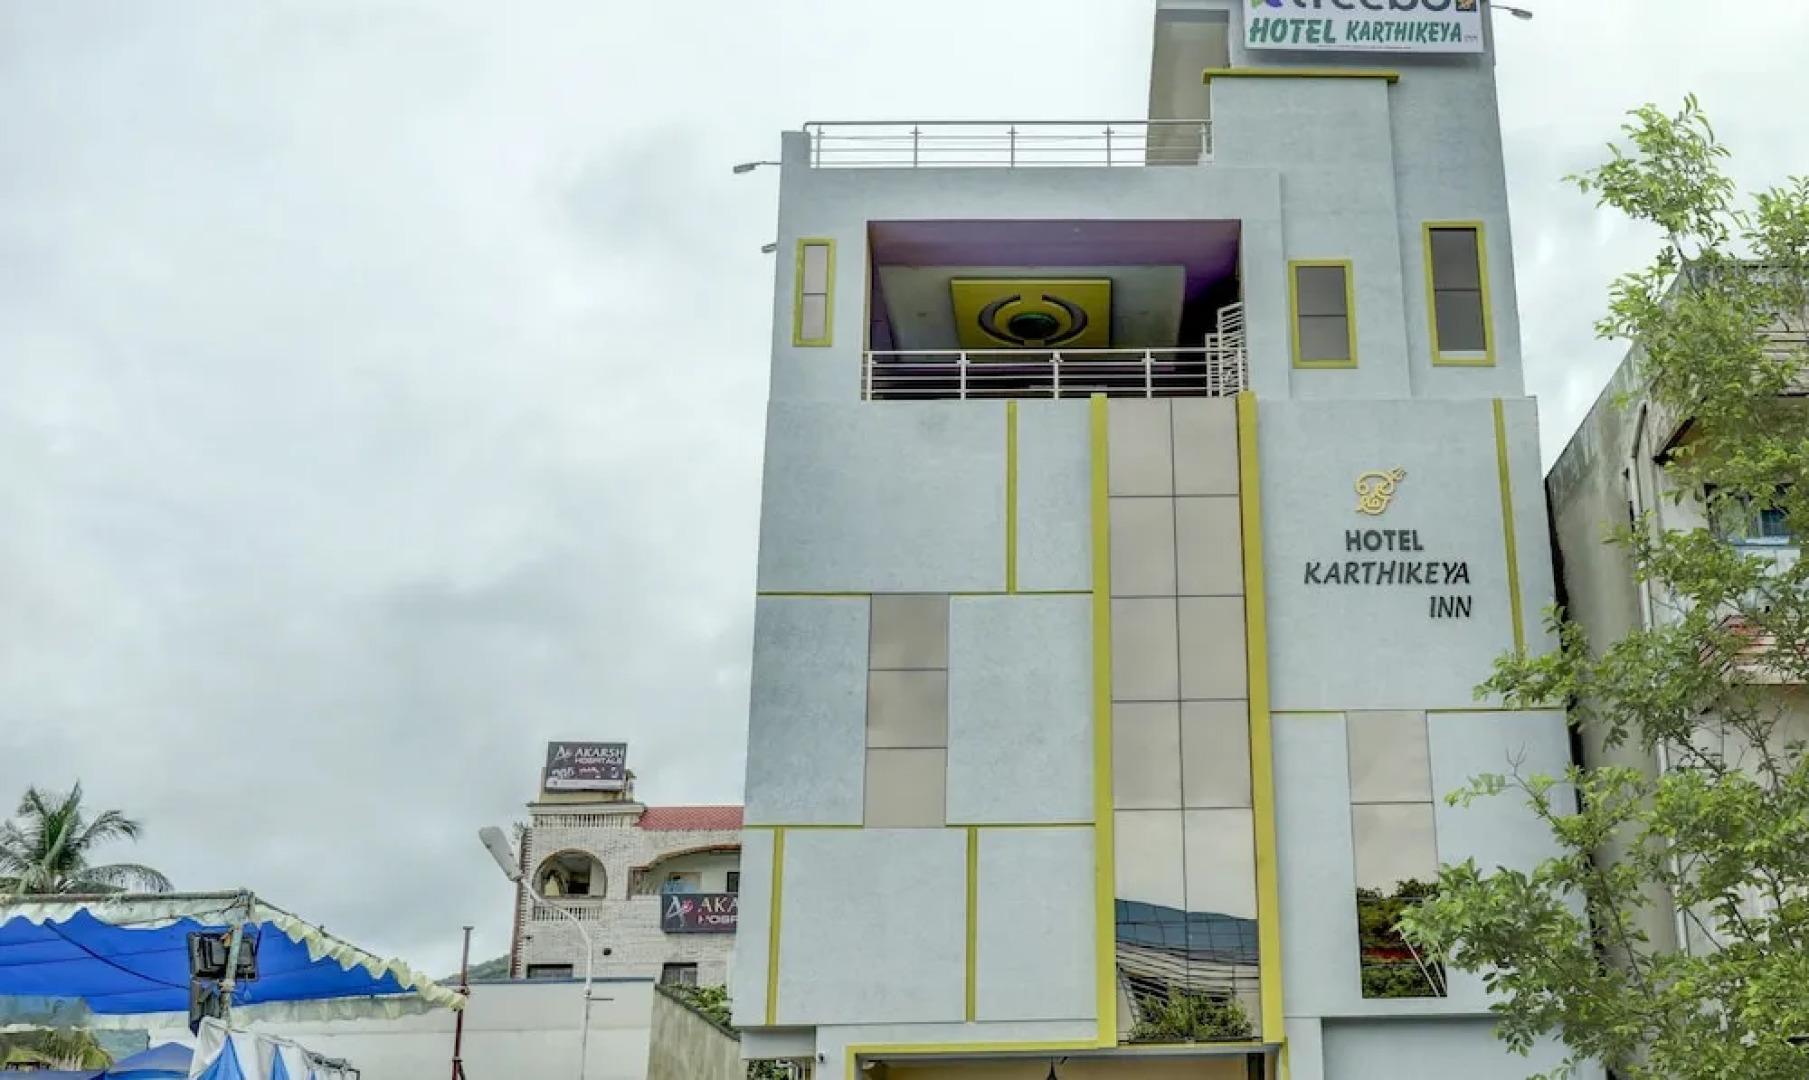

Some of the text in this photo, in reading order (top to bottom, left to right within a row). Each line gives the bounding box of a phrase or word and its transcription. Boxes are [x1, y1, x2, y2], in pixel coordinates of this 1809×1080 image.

[1249, 17, 1462, 44] HOTEL KARTHIKEYA
[1345, 529, 1424, 551] HOTEL
[1303, 561, 1471, 585] KARTHIKEYA
[1429, 595, 1472, 618] INN
[575, 746, 624, 757] AKARSH
